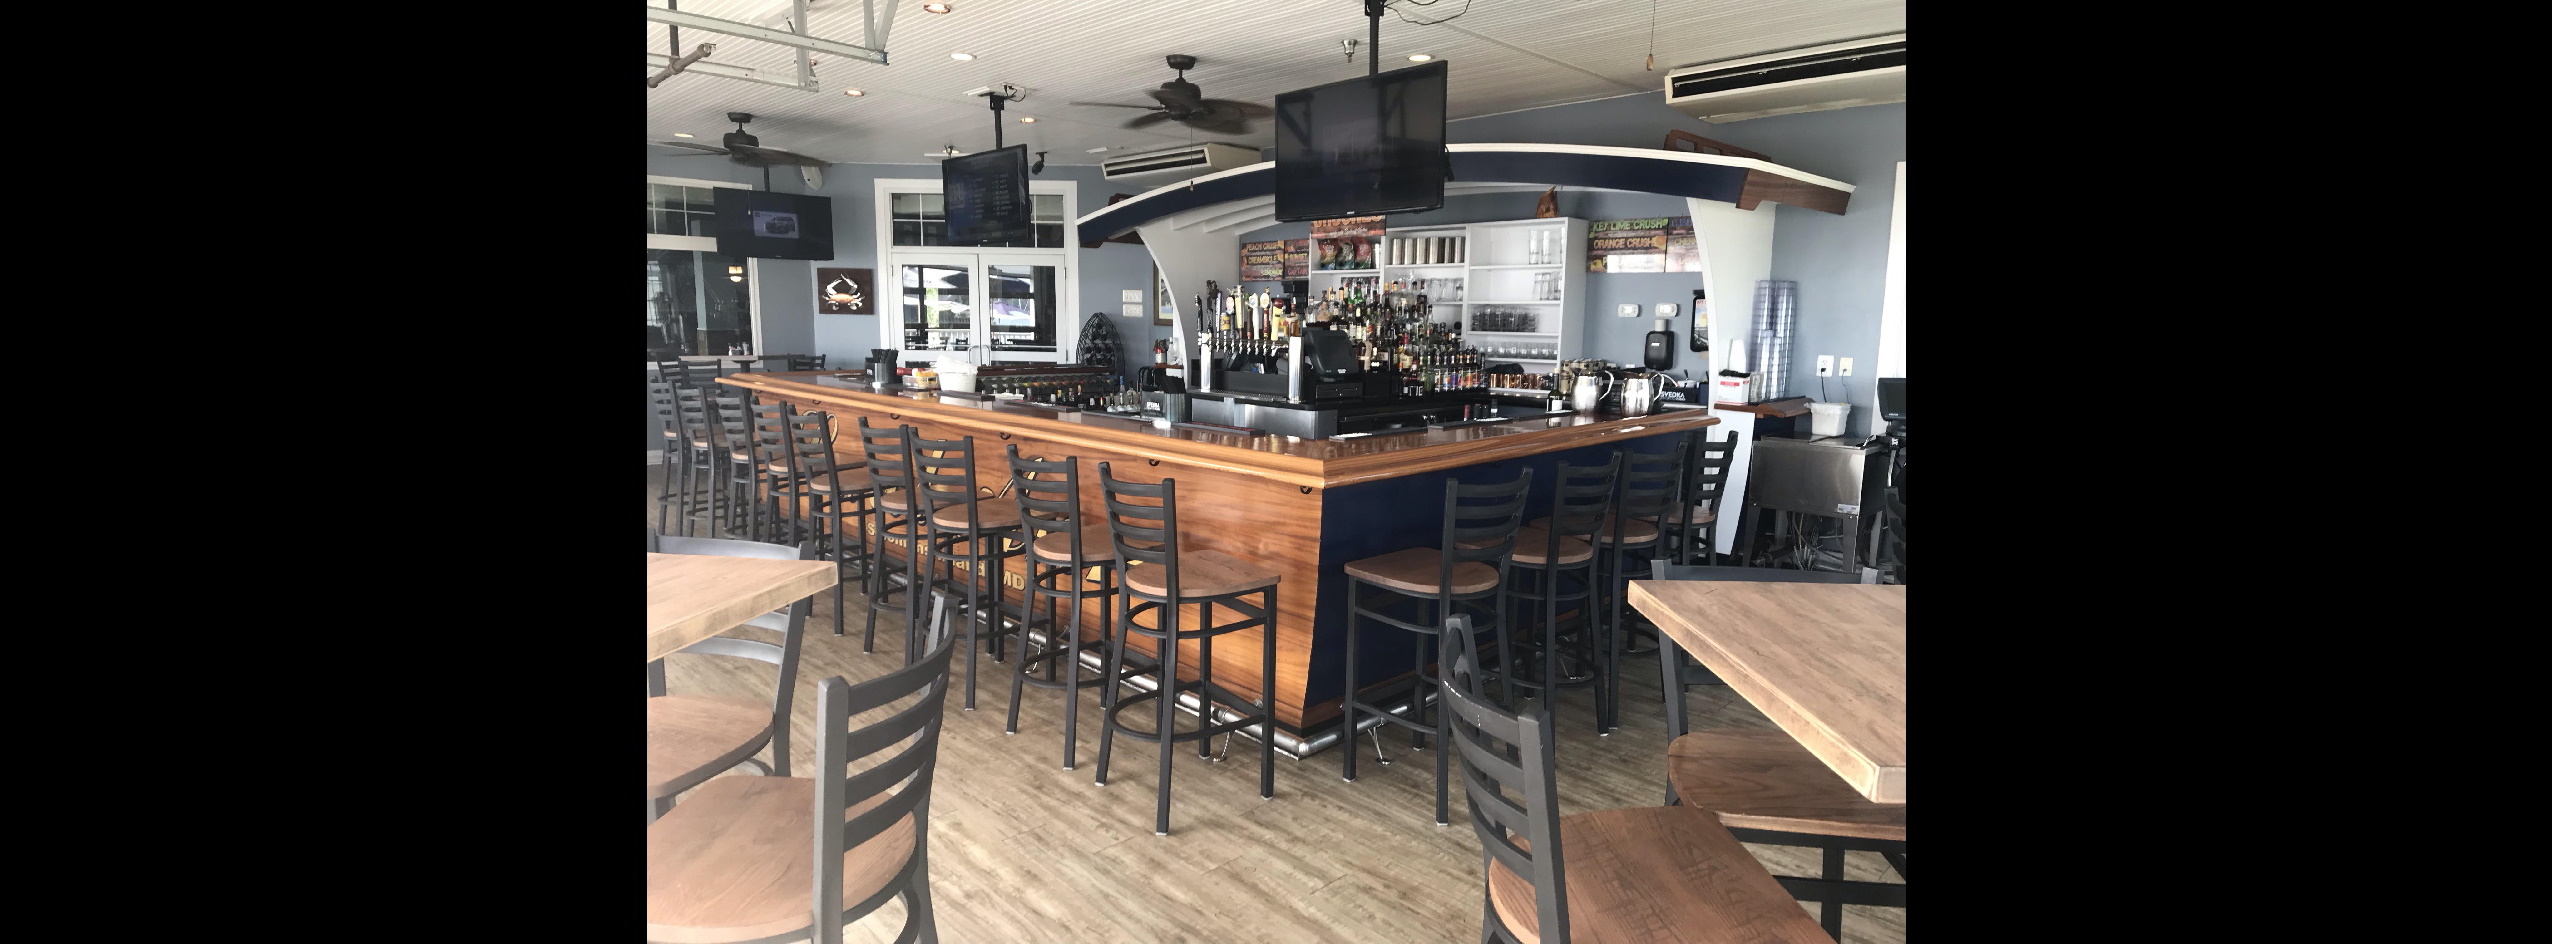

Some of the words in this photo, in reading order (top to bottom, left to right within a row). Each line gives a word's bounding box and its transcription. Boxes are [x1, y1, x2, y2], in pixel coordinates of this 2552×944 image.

[1592, 221, 1608, 232] KEY
[1610, 220, 1630, 231] LIME
[1633, 218, 1663, 230] CRUSH
[1593, 238, 1625, 249] ORANGE
[1627, 237, 1653, 248] CRUSH
[1003, 570, 1025, 591] MD
